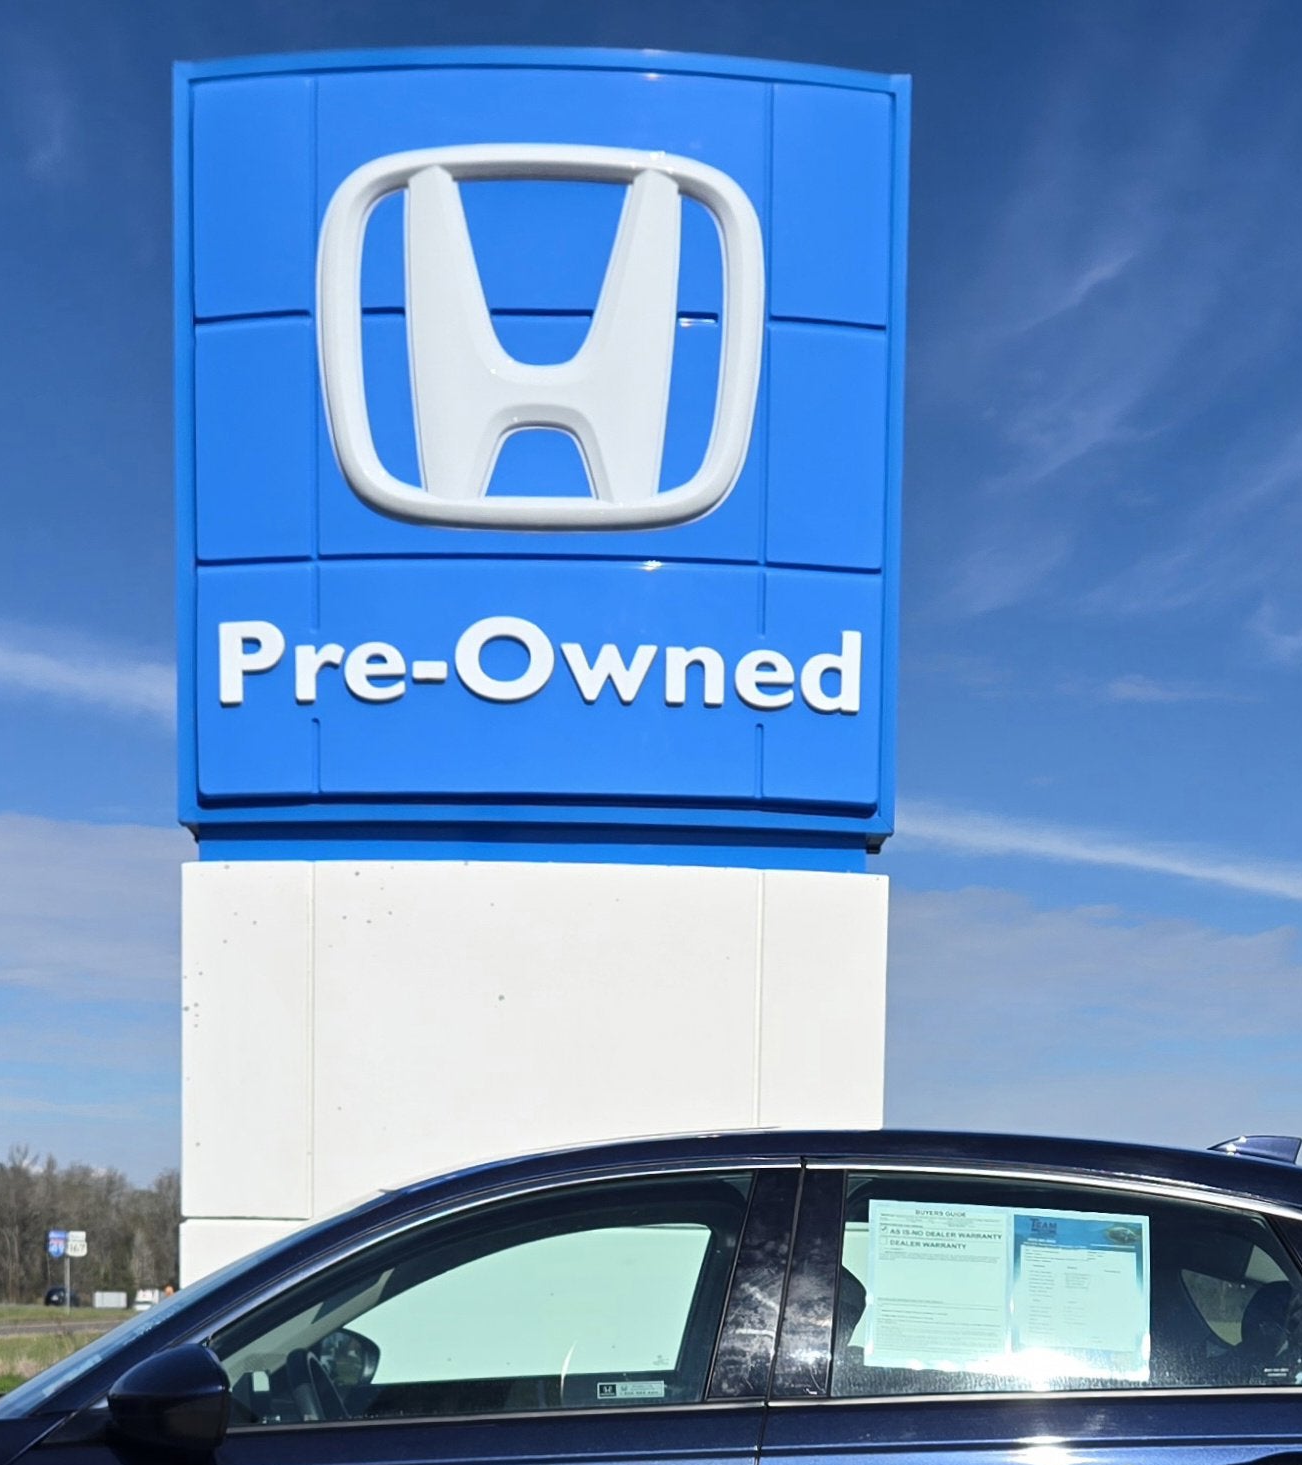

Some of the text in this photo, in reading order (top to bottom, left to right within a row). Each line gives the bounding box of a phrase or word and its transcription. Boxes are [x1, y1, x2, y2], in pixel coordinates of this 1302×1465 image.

[218, 616, 862, 714] Pre-Owned
[915, 1209, 943, 1217] BUYERS
[925, 1231, 956, 1239] DEALER
[958, 1232, 1002, 1240] WARRANTY
[890, 1240, 967, 1249] DEALER WARRANTY
